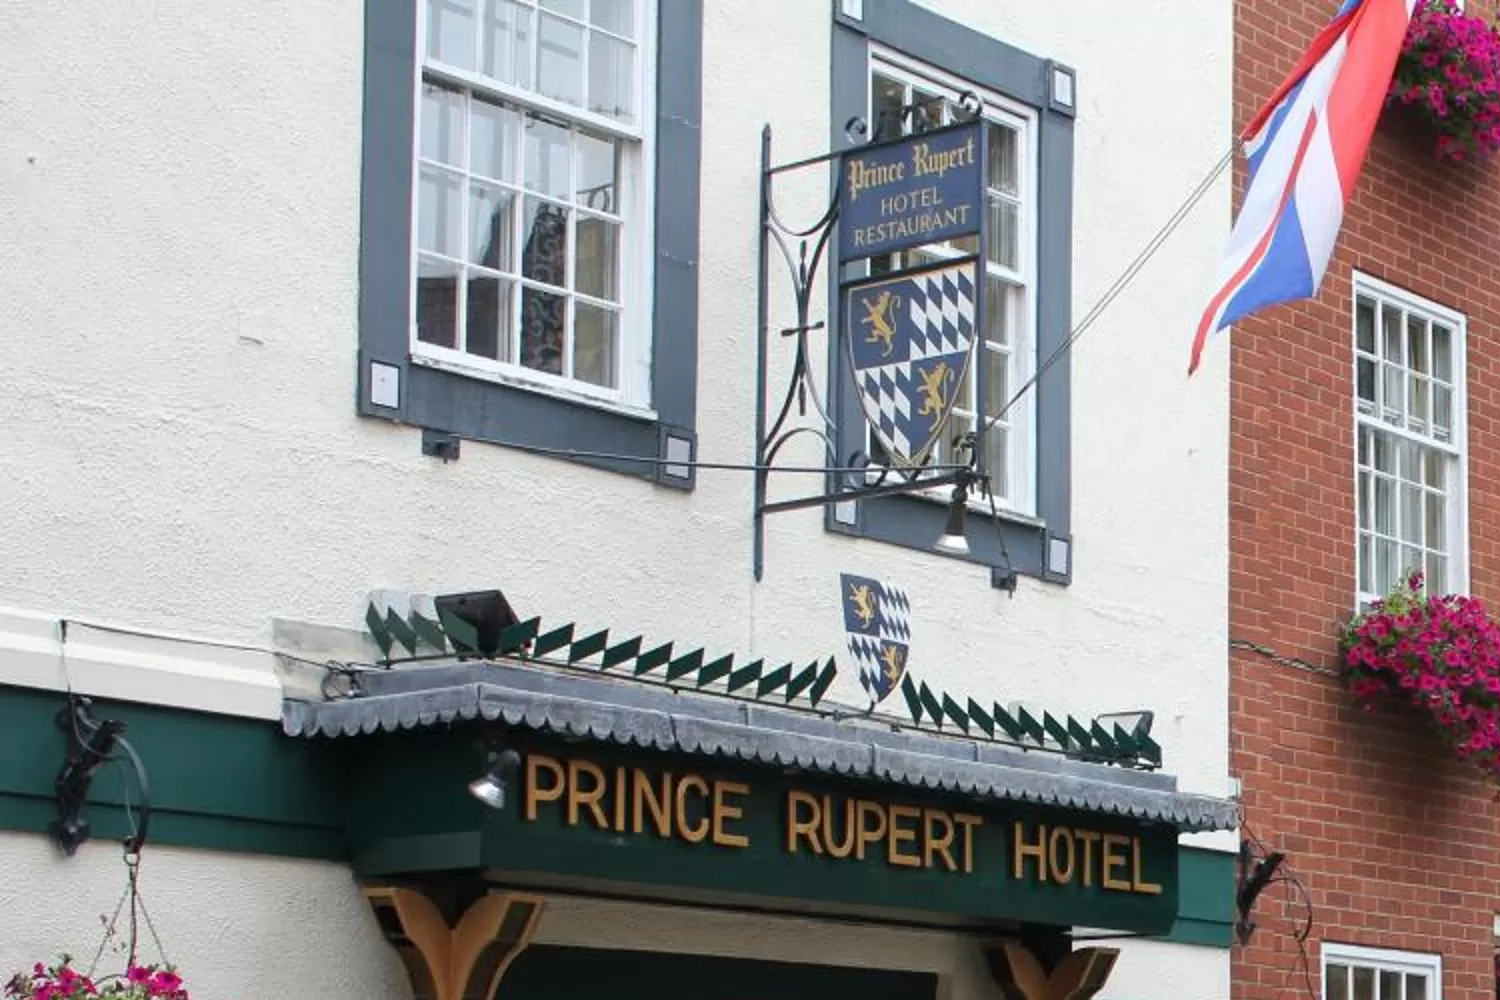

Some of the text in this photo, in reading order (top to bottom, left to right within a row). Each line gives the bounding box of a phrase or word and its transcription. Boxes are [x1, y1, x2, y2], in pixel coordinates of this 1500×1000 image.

[848, 136, 976, 201] Prince Rupert
[853, 206, 970, 247] RESTAURANT
[880, 185, 943, 216] HOTEL
[525, 755, 1164, 896] PRINCE RUPERT HOTEL
